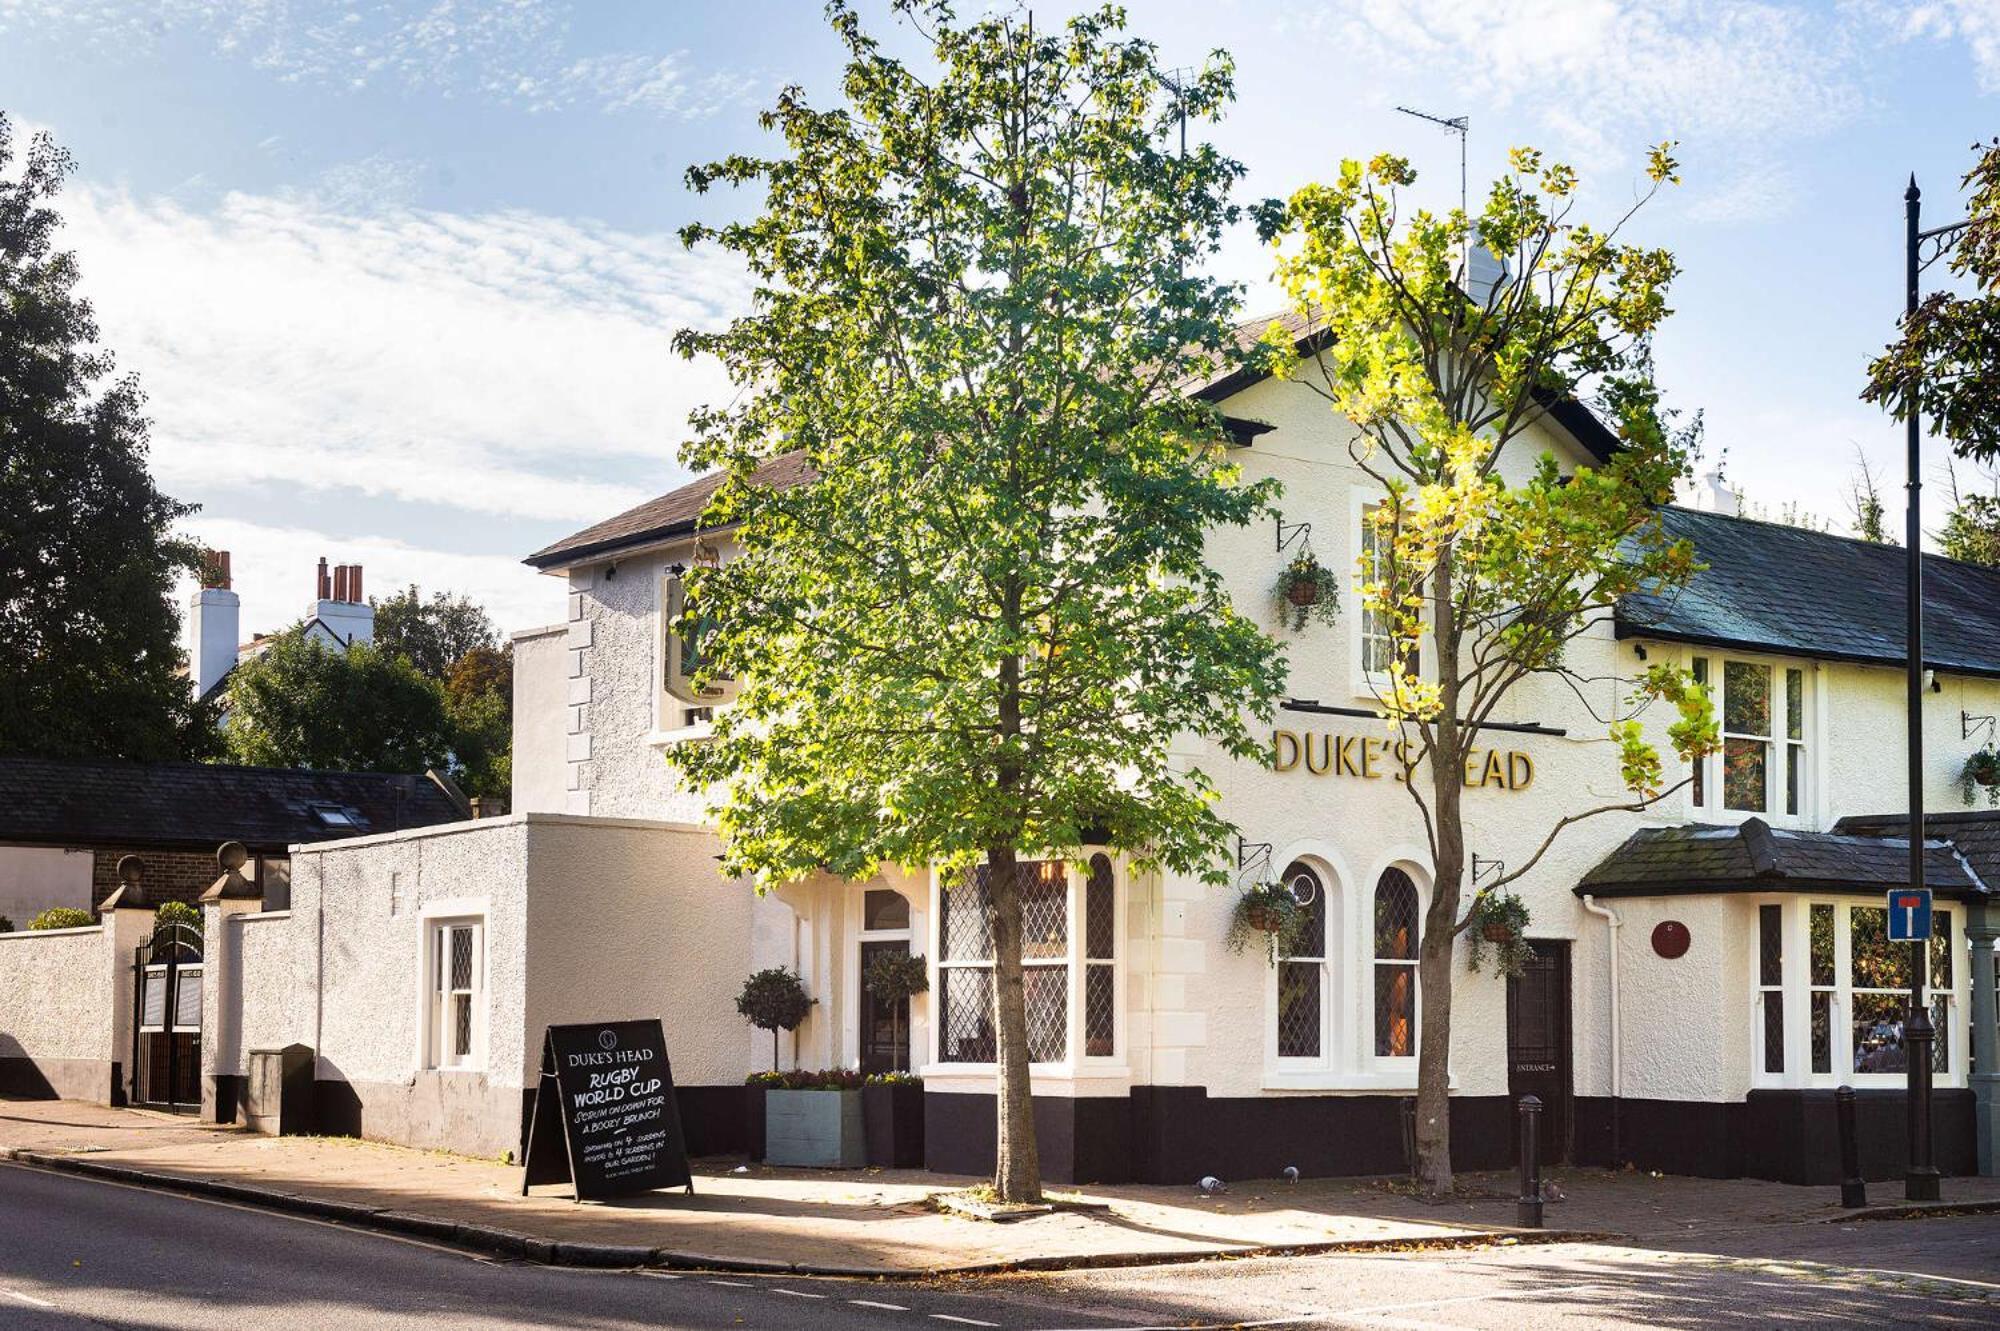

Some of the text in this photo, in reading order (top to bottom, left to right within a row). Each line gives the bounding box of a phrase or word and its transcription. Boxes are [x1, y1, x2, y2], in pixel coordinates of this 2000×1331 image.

[1273, 730, 1535, 791] DUKE'S EAD
[568, 1048, 653, 1067] DUKE'S HEAD
[589, 1066, 640, 1089] RUGBY
[574, 1078, 661, 1109] WORLD CUP
[574, 1095, 665, 1124] SCRUM ON DOWN FOR
[582, 1107, 661, 1134] A BOOZY BRUNCH
